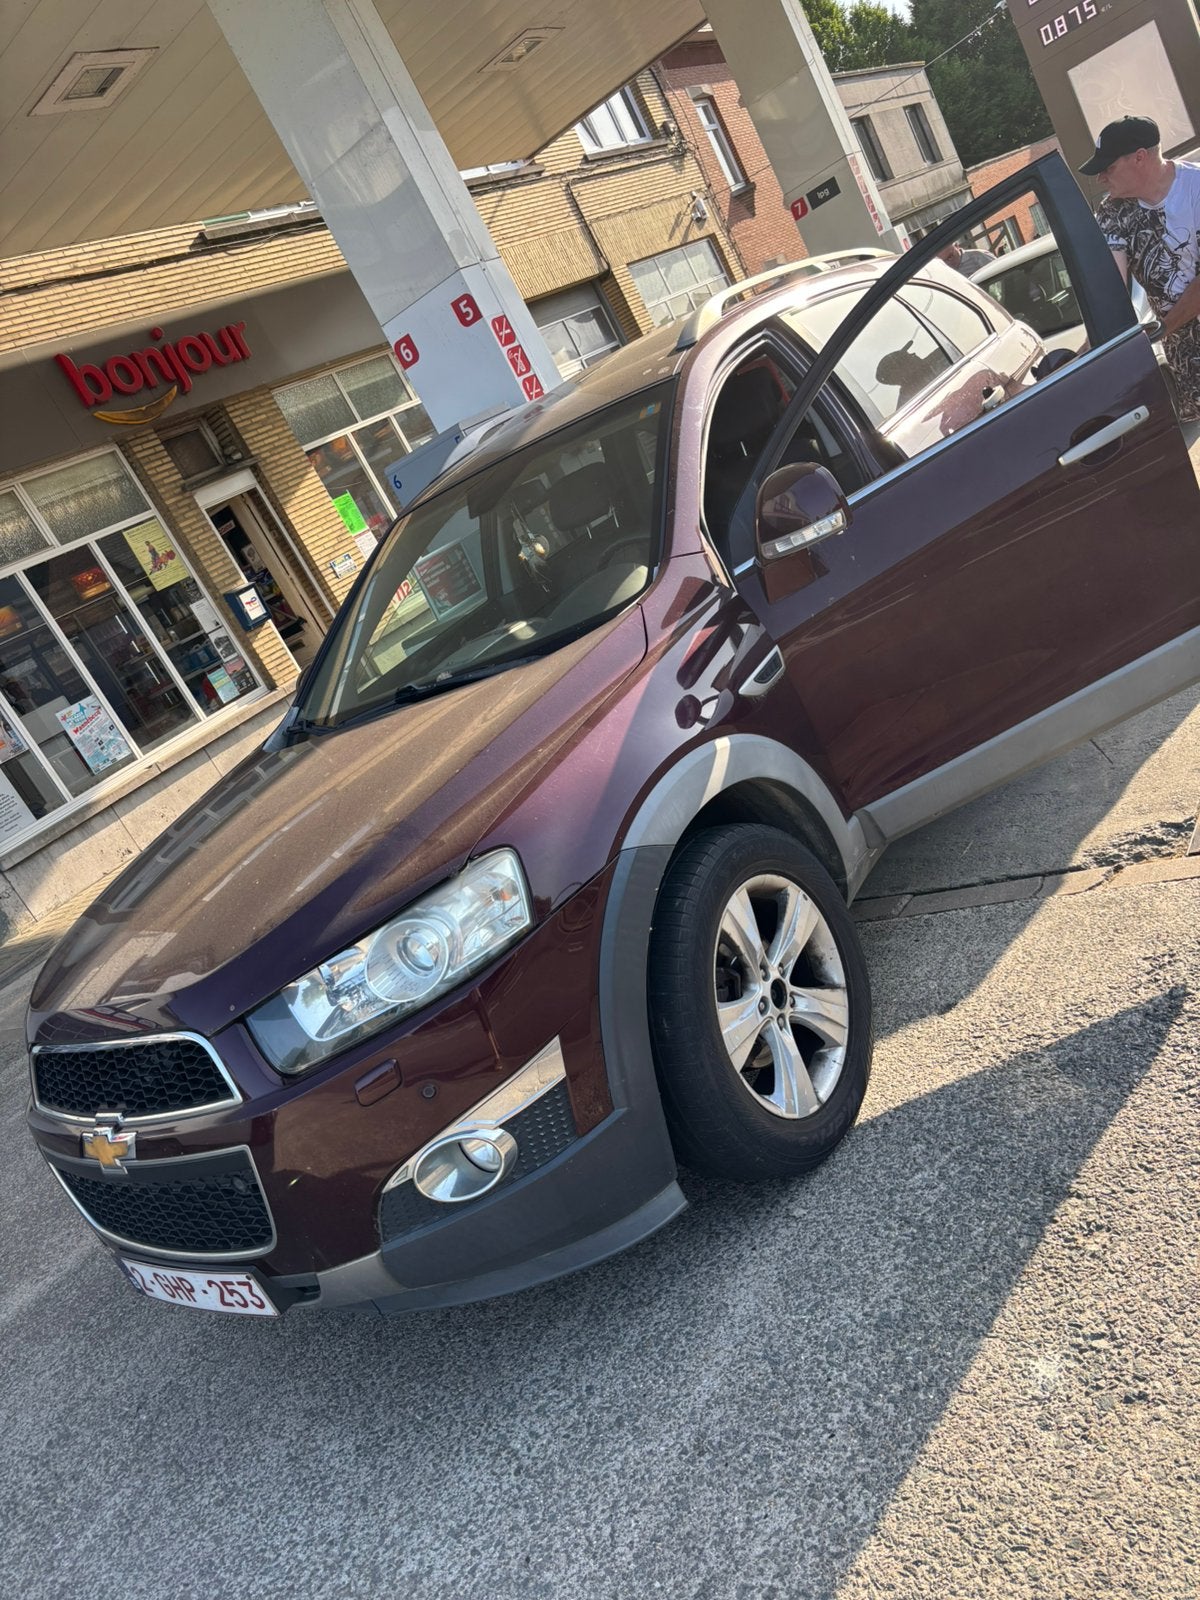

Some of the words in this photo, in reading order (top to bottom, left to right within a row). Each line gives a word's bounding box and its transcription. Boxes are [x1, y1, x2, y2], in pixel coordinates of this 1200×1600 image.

[1040, 0, 1097, 46] 0.875
[794, 202, 802, 216] 7
[816, 188, 830, 199] lpg
[458, 299, 474, 321] 5
[54, 321, 251, 408] bonjour
[400, 343, 413, 362] 6
[393, 475, 403, 489] 6
